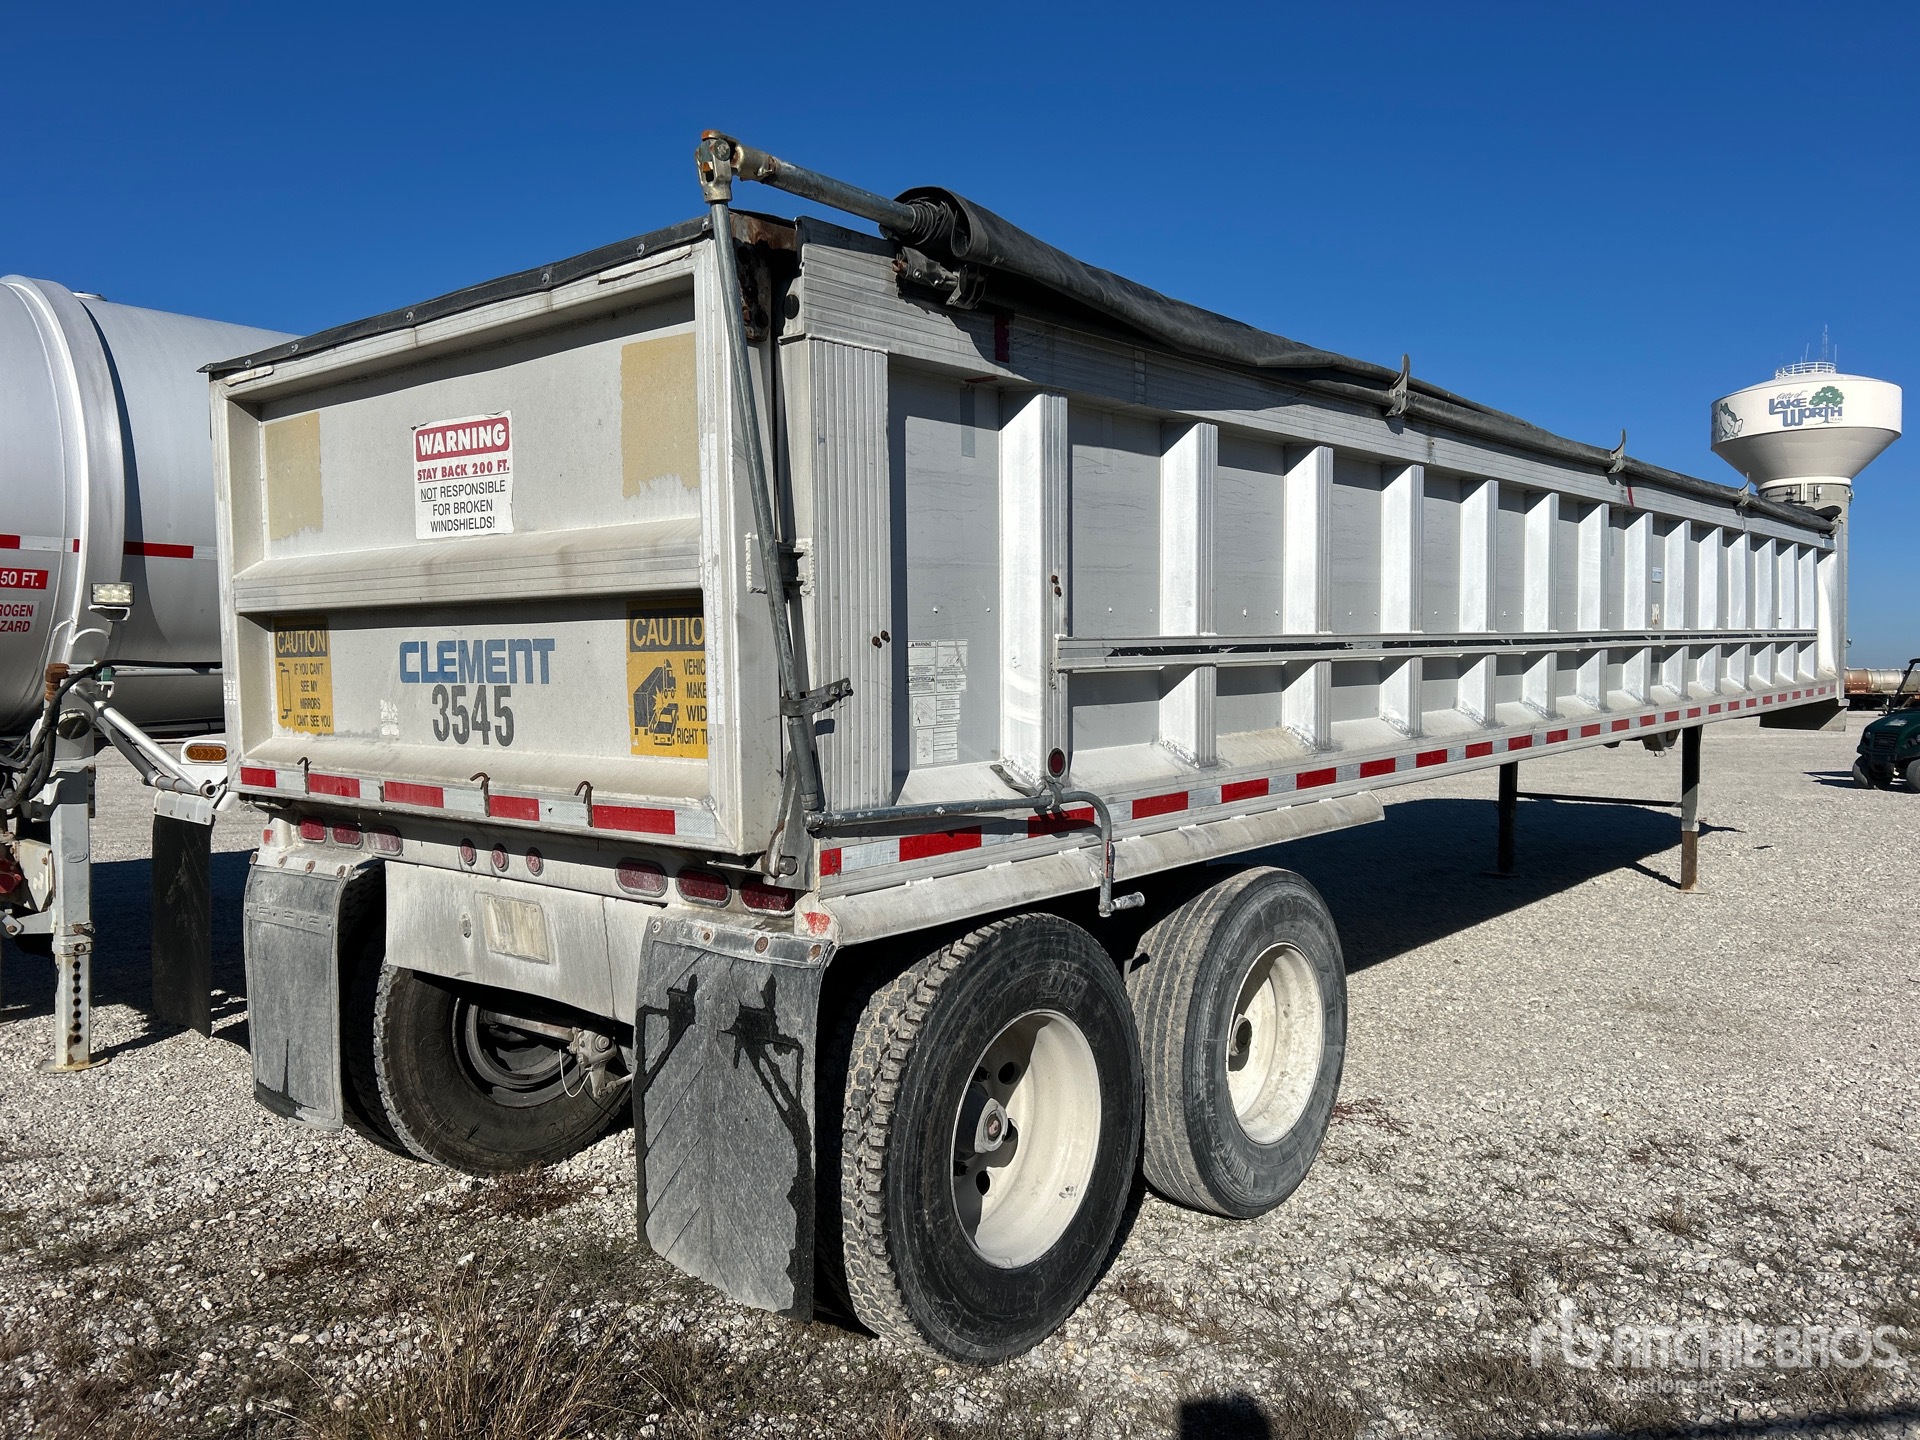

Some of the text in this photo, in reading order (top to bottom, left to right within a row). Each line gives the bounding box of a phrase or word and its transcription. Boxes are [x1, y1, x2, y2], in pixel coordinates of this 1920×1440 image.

[1769, 398, 1807, 415] LAKE
[1783, 406, 1843, 427] WORTH
[418, 423, 506, 456] WARNING
[417, 459, 510, 481] STAY BACK 200 FT.
[420, 480, 506, 500] NOT RESPONSIBLE
[432, 499, 493, 516] FOR BROKEN
[430, 516, 496, 532] WINDSHIELDS!
[21, 572, 39, 587] FT.
[276, 629, 326, 654] CAUTION
[299, 663, 309, 675] YOU
[400, 638, 556, 685] CLEMENT
[300, 680, 318, 692] SEE MY
[686, 681, 707, 699] MAKE
[300, 697, 321, 710] MIRRORS
[310, 715, 320, 727] SEE
[321, 715, 331, 727] YOU
[431, 684, 514, 747] 3545
[676, 727, 698, 745] RIGHT
